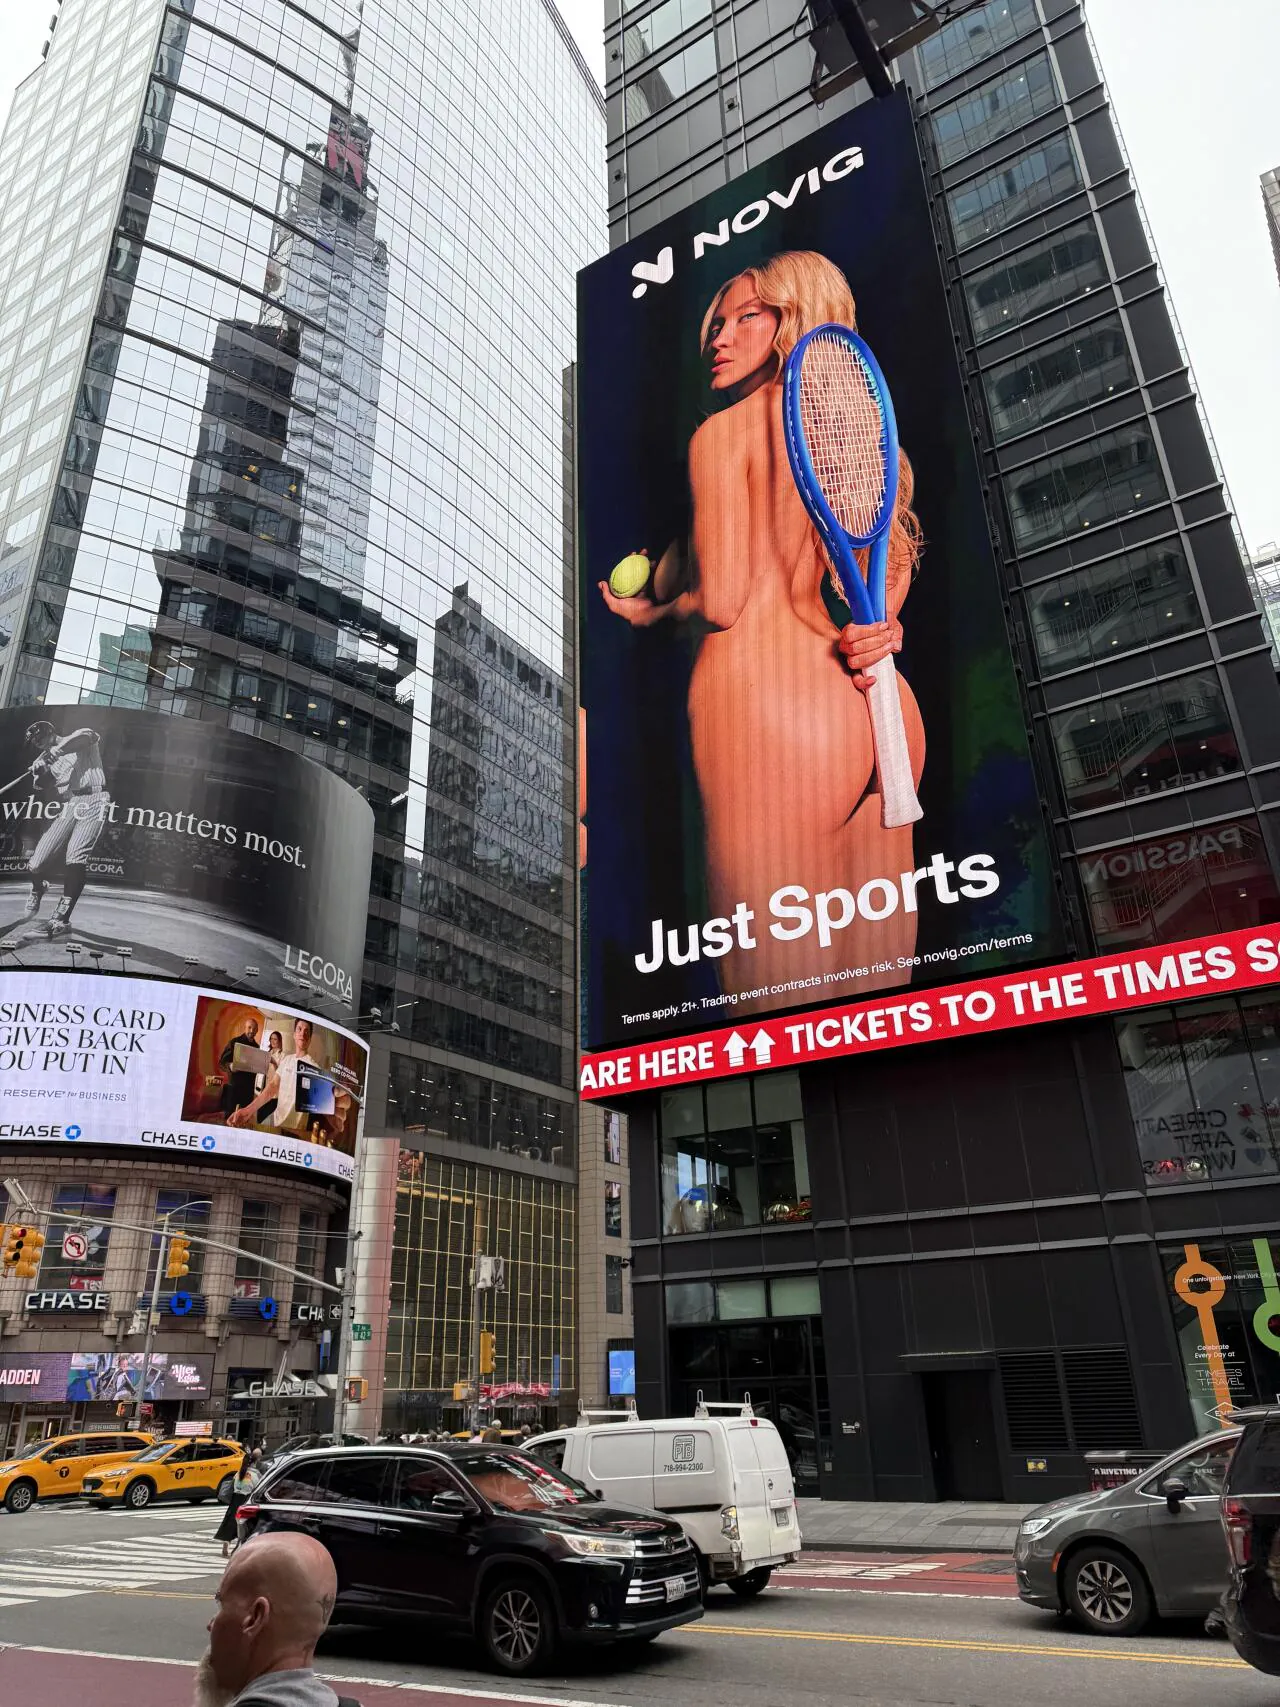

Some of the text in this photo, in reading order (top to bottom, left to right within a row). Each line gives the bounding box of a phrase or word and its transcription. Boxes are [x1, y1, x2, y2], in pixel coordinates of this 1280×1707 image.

[693, 146, 865, 260] NOVIG
[2, 794, 91, 820] where
[124, 806, 237, 845] matters
[242, 831, 306, 869] most.
[85, 863, 124, 875] GORA
[634, 852, 1001, 974] Just Sports
[284, 944, 353, 1001] LEGORA
[621, 933, 1033, 1025] Terms apply. 21+. Trading event contracts involves risk. See novig.com/terms
[0, 1002, 166, 1031] SINESS CARD
[580, 937, 1280, 1092] ARE HERE TICKETS TO THE TIMES S
[77, 1028, 147, 1054] BACK
[42, 1050, 95, 1073] PUT
[100, 1055, 129, 1076] IN
[79, 1091, 127, 1102] BUSINESS
[0, 1124, 62, 1138] CHASE
[141, 1131, 199, 1148] CHASE
[262, 1145, 302, 1164] CHASE
[338, 1164, 354, 1180] CHAS
[25, 1293, 109, 1310] CHASE
[1213, 1351, 1227, 1359] Day
[0, 1370, 41, 1384] ADDEN
[249, 1382, 316, 1396] CHASE
